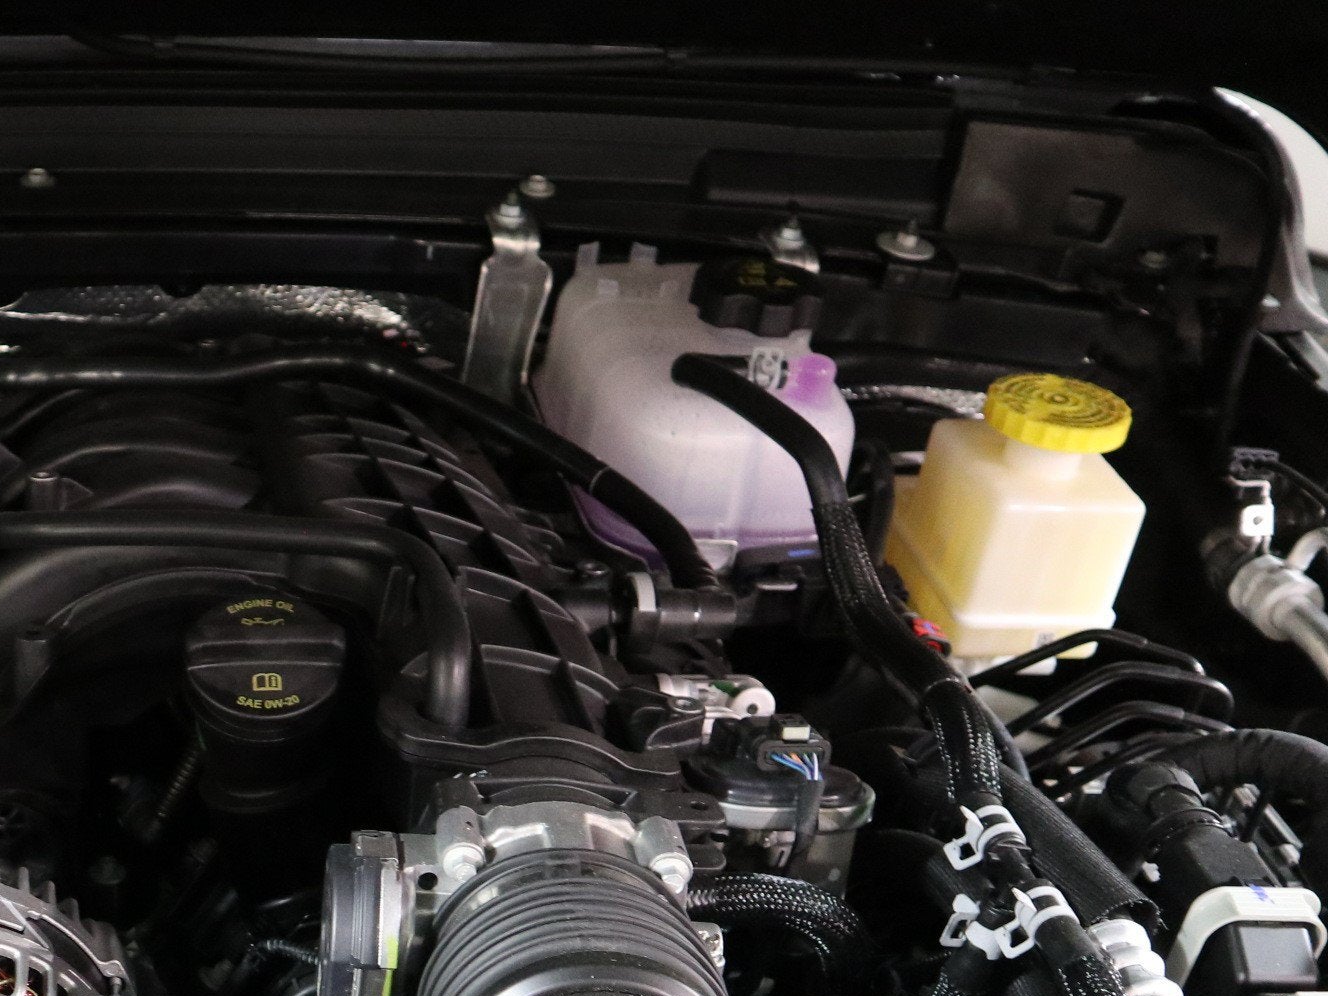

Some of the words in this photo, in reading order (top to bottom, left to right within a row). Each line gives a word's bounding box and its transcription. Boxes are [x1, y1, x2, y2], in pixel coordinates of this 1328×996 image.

[225, 599, 273, 614] ENGINE
[275, 601, 295, 613] OIL
[236, 695, 262, 709] SAE
[264, 694, 300, 709] 0W-20
